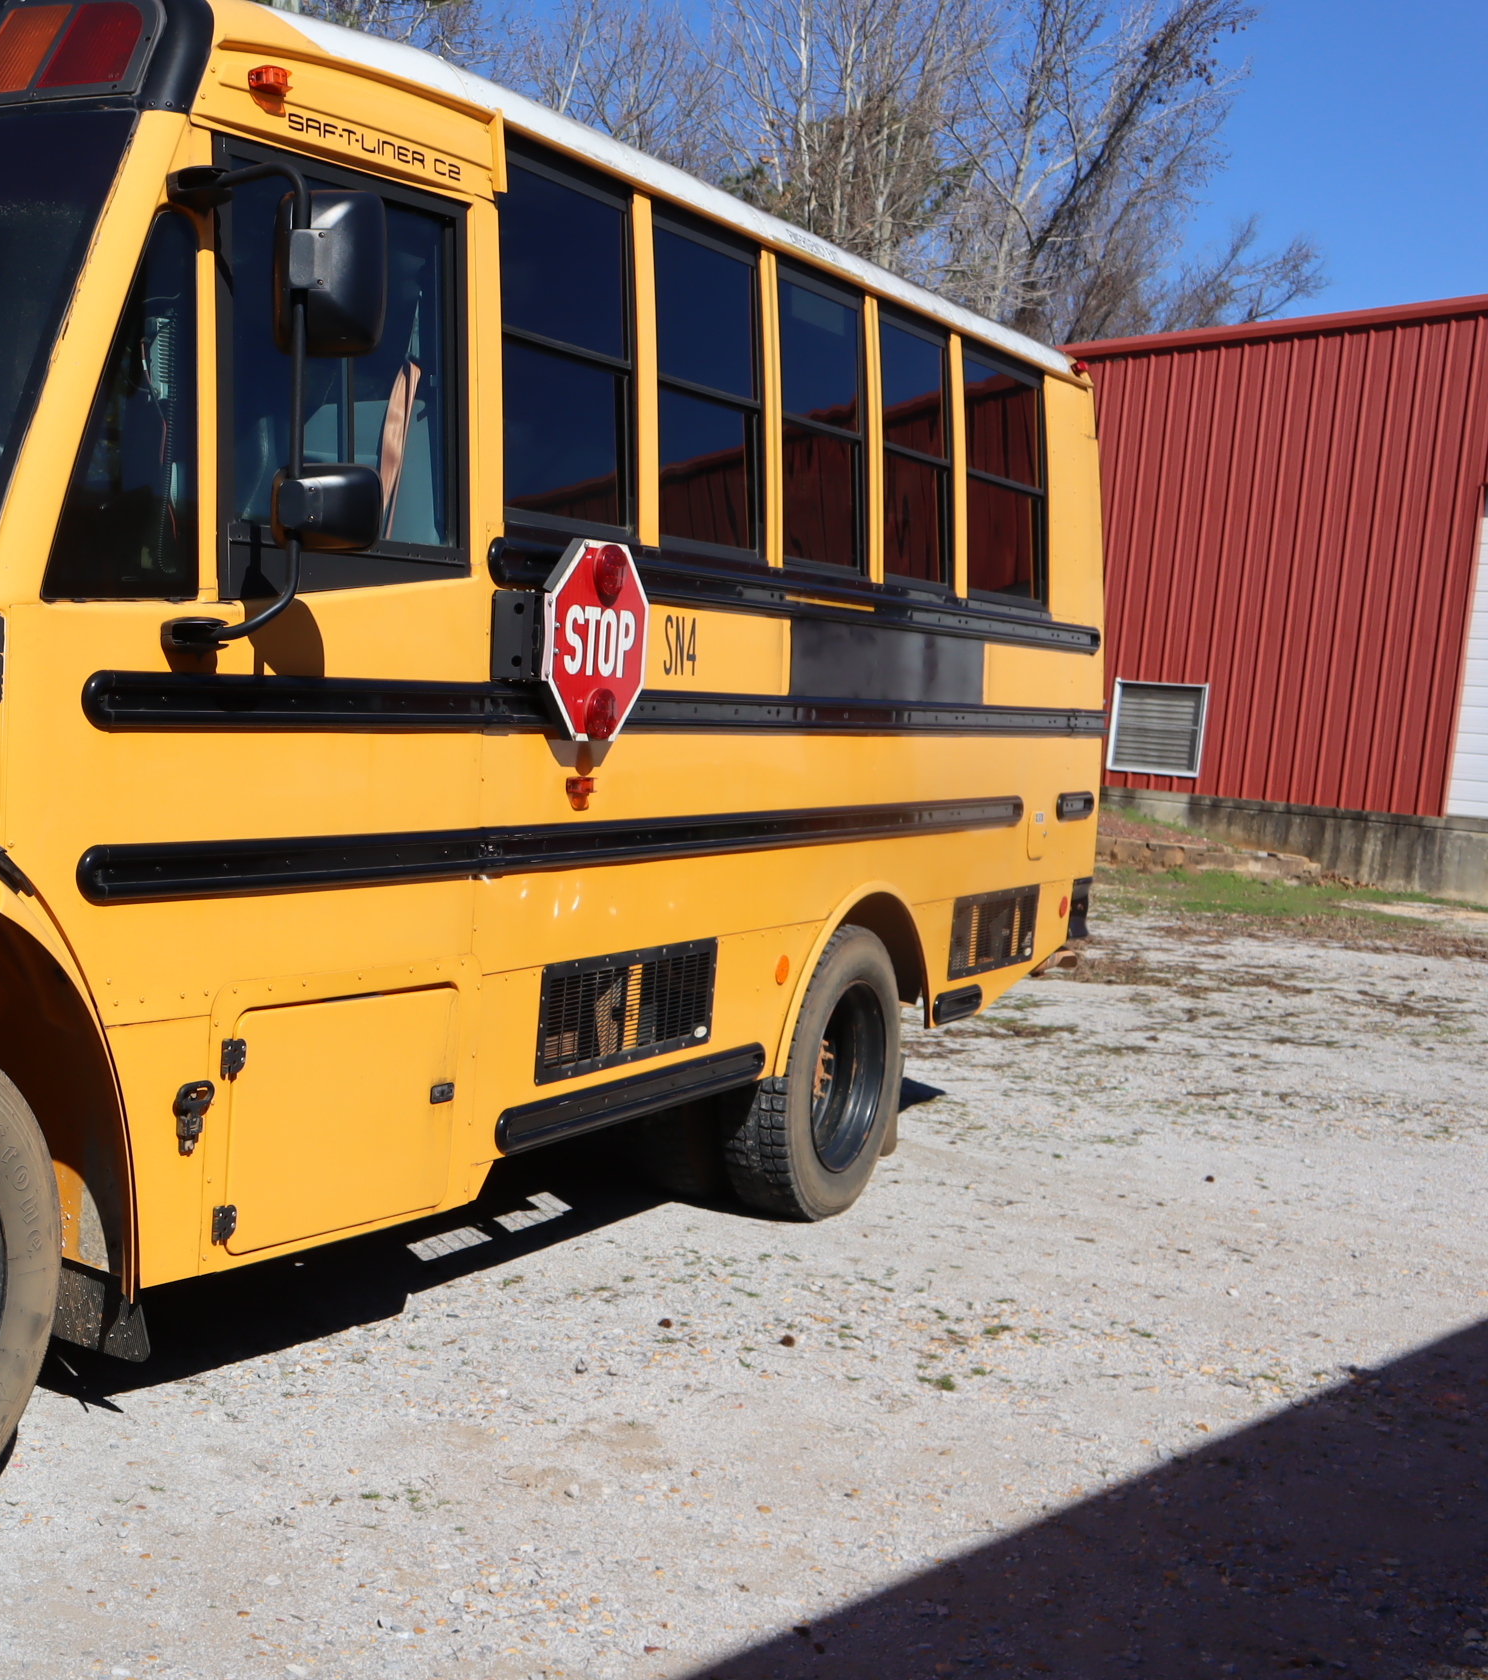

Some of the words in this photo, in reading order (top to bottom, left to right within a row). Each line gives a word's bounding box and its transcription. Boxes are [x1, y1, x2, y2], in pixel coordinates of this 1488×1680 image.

[288, 113, 425, 169] SAF-T-LINER
[434, 158, 461, 182] C2
[563, 604, 636, 678] STOP
[664, 614, 696, 676] SN4
